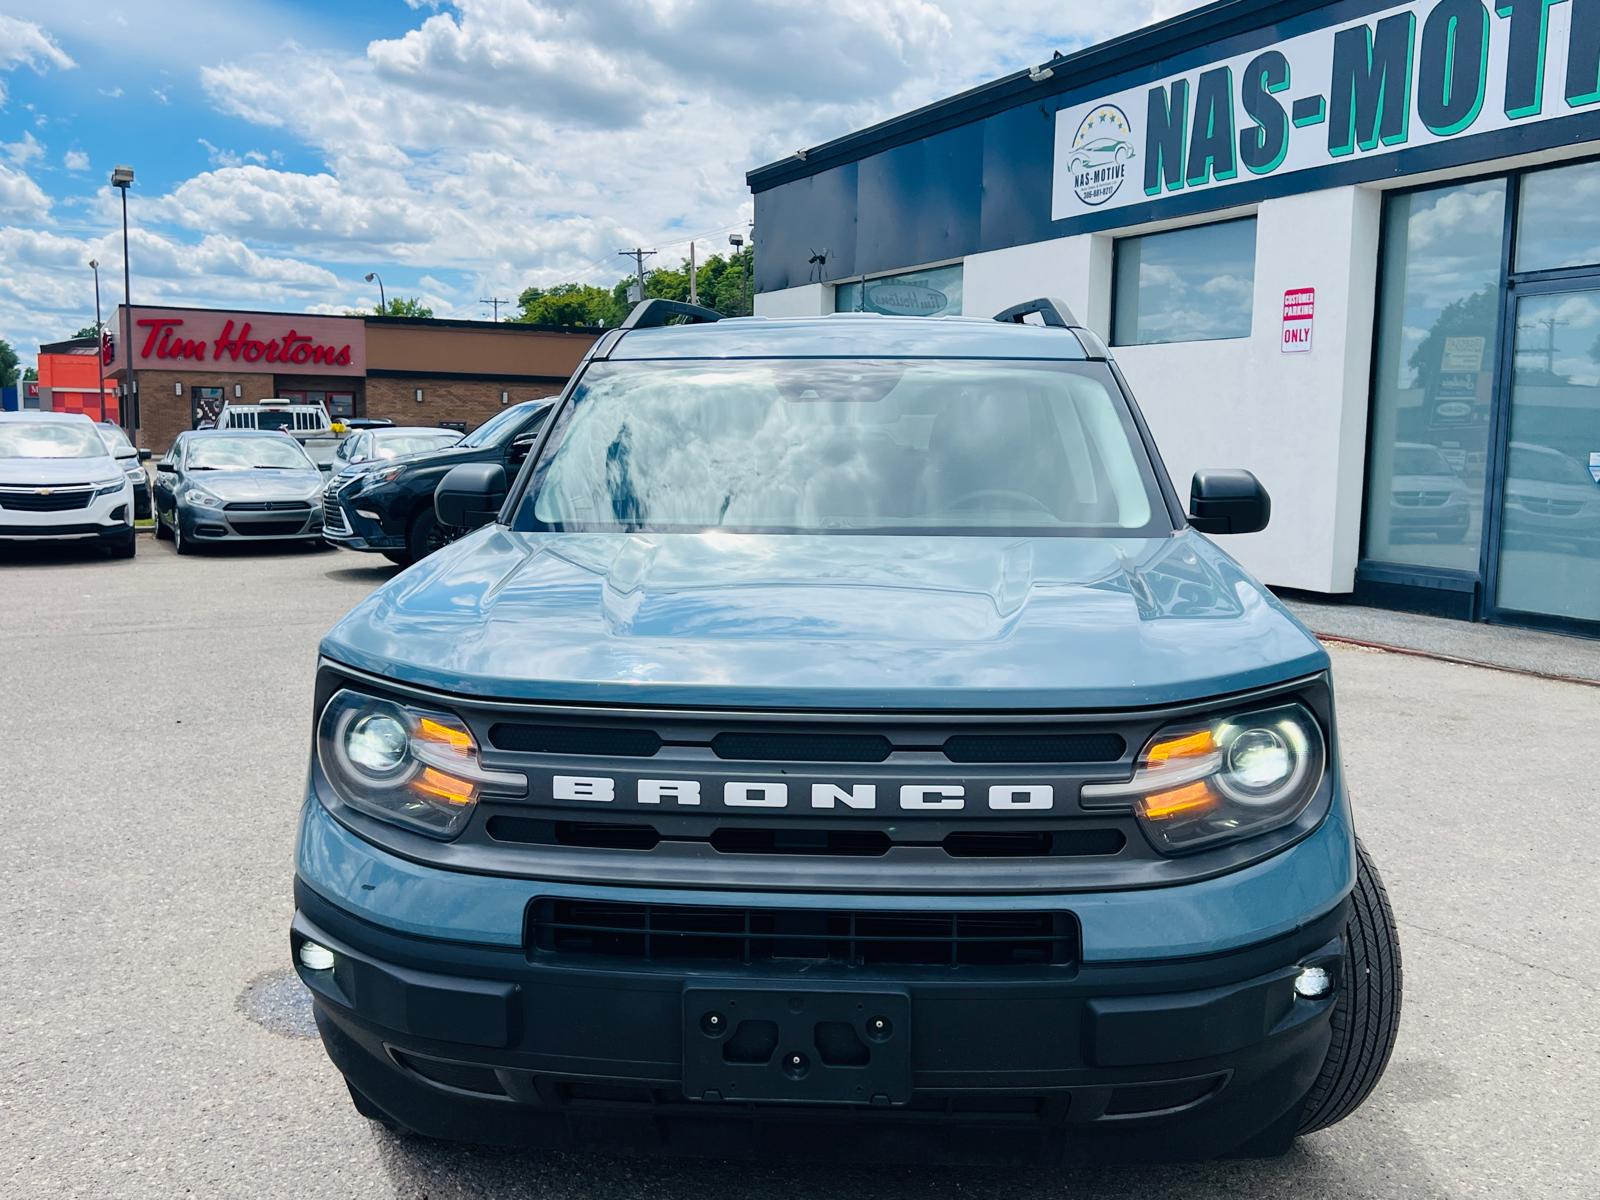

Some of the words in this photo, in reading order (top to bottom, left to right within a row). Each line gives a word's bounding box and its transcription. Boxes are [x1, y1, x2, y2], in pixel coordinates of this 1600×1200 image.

[1074, 164, 1125, 188] NAS-MOTIVE
[1284, 304, 1313, 316] PARKING
[137, 318, 207, 361] Tim
[213, 319, 352, 366] Hortons
[1284, 328, 1310, 343] ONLY
[552, 775, 1054, 810] BRONCO
